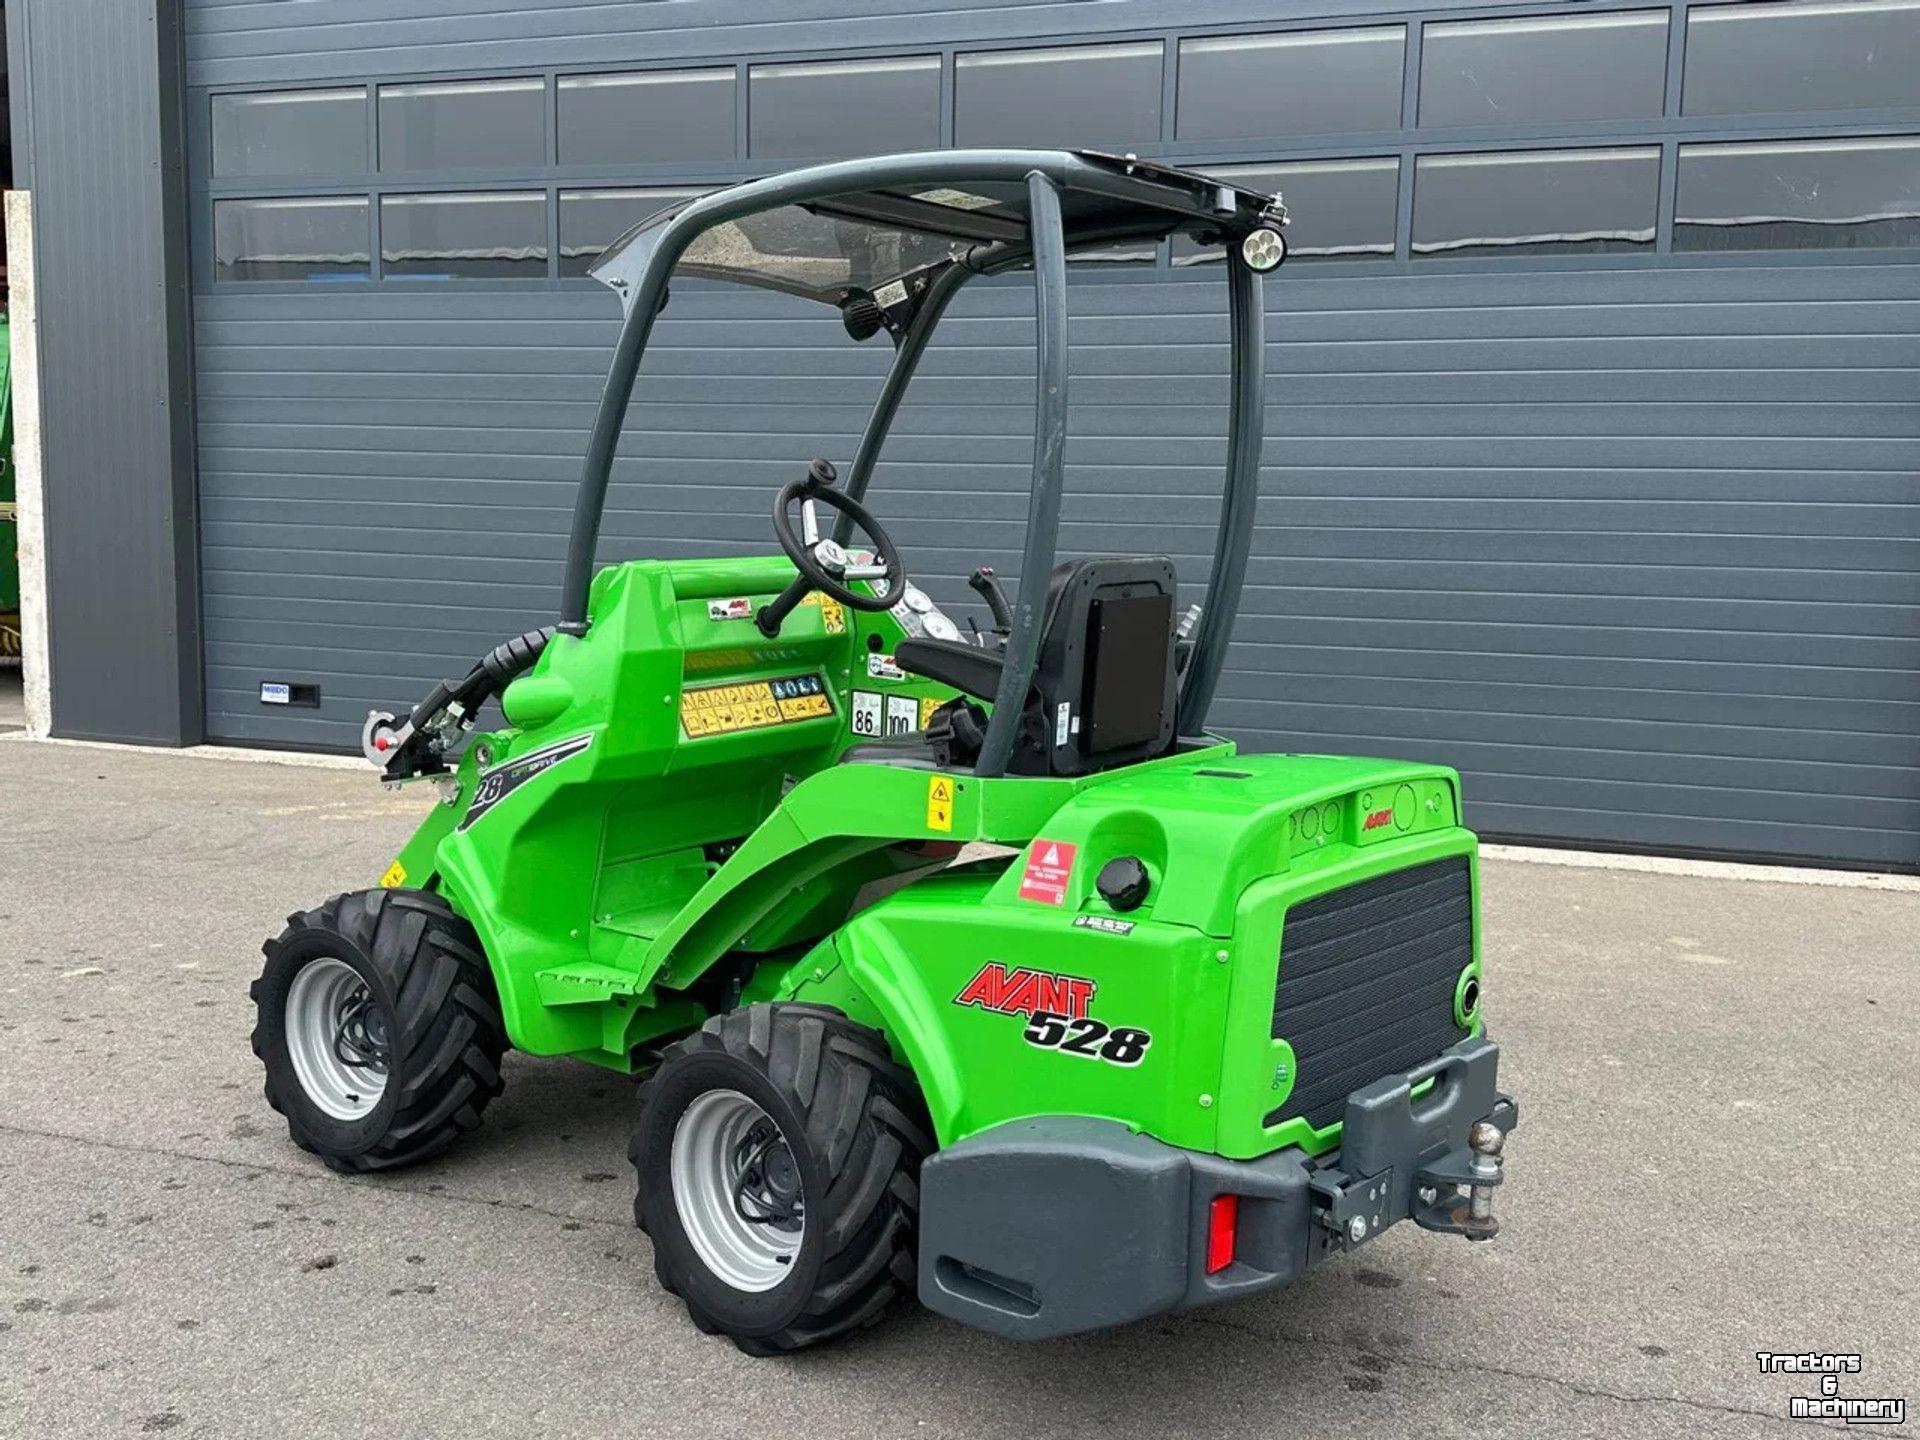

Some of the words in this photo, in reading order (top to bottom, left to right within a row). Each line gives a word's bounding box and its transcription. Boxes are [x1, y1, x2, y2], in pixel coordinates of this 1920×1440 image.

[855, 709, 873, 733] 86
[889, 715, 909, 735] 100
[953, 961, 1097, 1021] AVANT
[1023, 1010, 1151, 1066] 528
